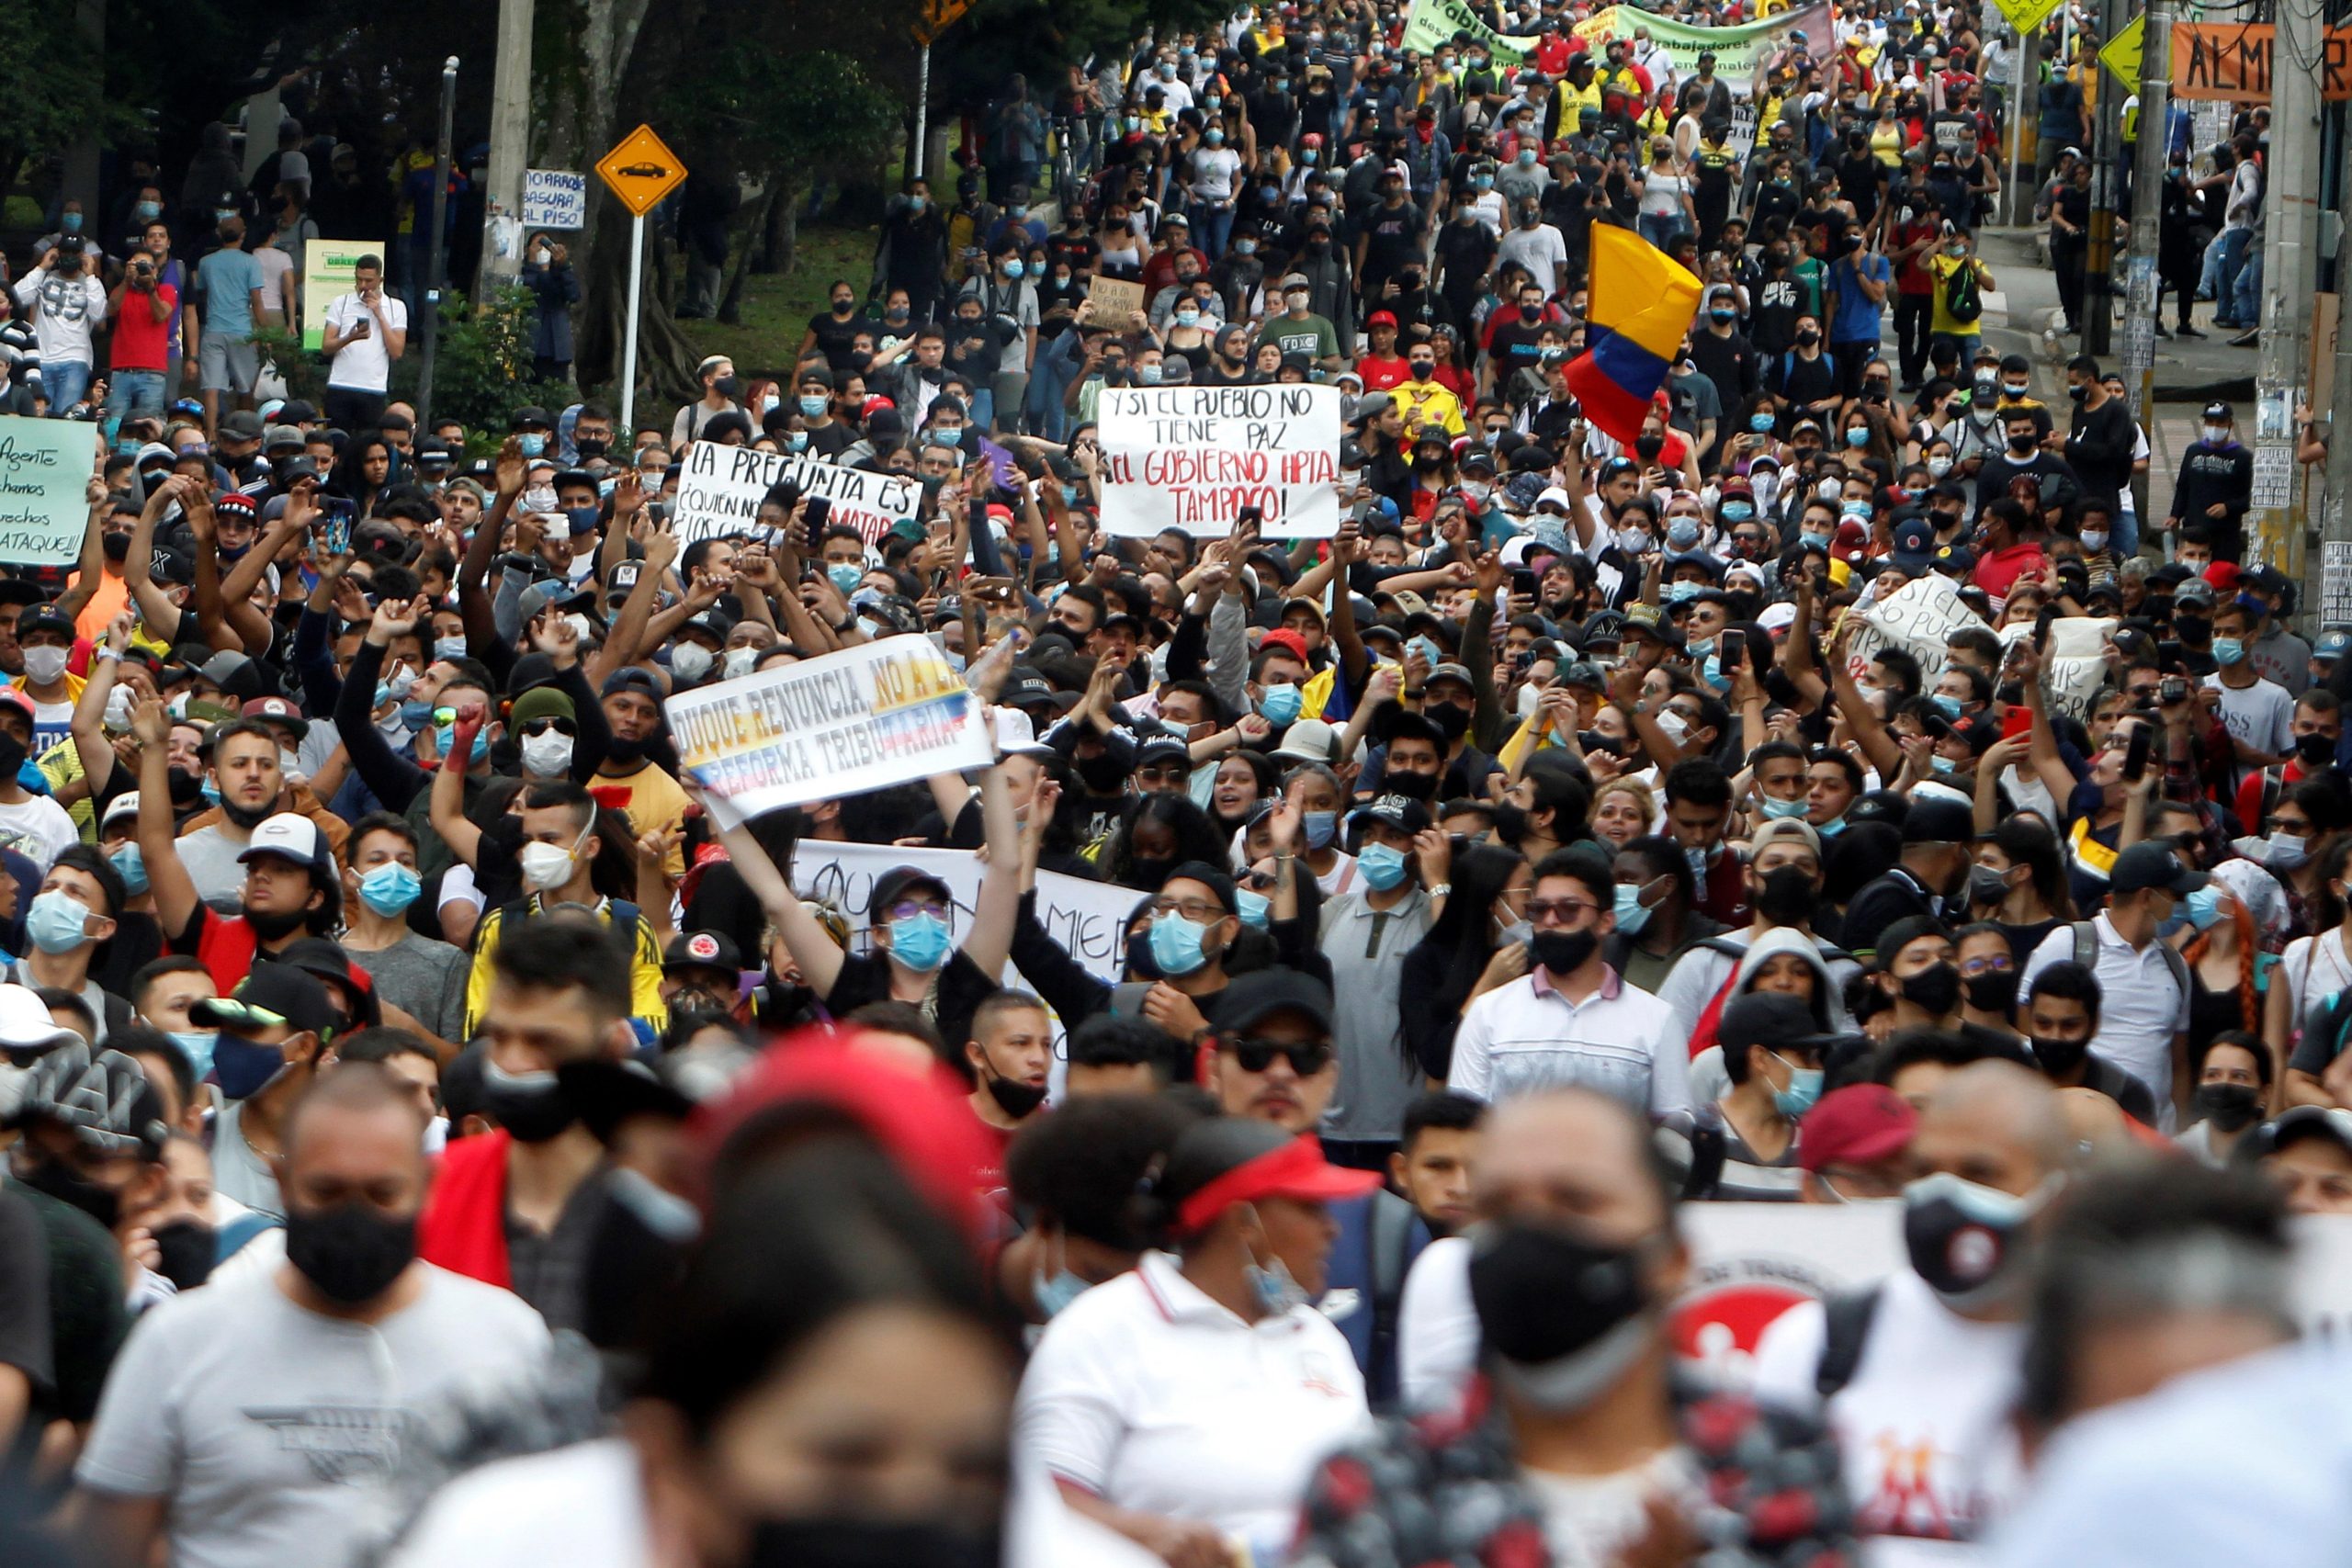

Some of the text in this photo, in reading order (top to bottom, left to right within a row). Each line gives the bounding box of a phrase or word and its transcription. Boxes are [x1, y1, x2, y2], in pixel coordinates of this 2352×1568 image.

[1653, 39, 1751, 51] rabajadores
[1283, 337, 1306, 349] FOX
[1105, 387, 1314, 420] Y SI EL PUEBLO NO
[1148, 418, 1288, 451] TIENE PAZ
[691, 442, 910, 514] LA PREGUNTA ES
[1112, 452, 1136, 485] EL
[1145, 449, 1269, 486] GOBIERNO
[0, 474, 45, 497] hamos
[0, 506, 51, 525] rechos
[1905, 610, 1951, 643] PUE
[672, 696, 748, 758] DUQUE
[869, 654, 906, 709] NO
[907, 648, 928, 695] A
[704, 701, 963, 797] REFORMA TRIBUTARIA
